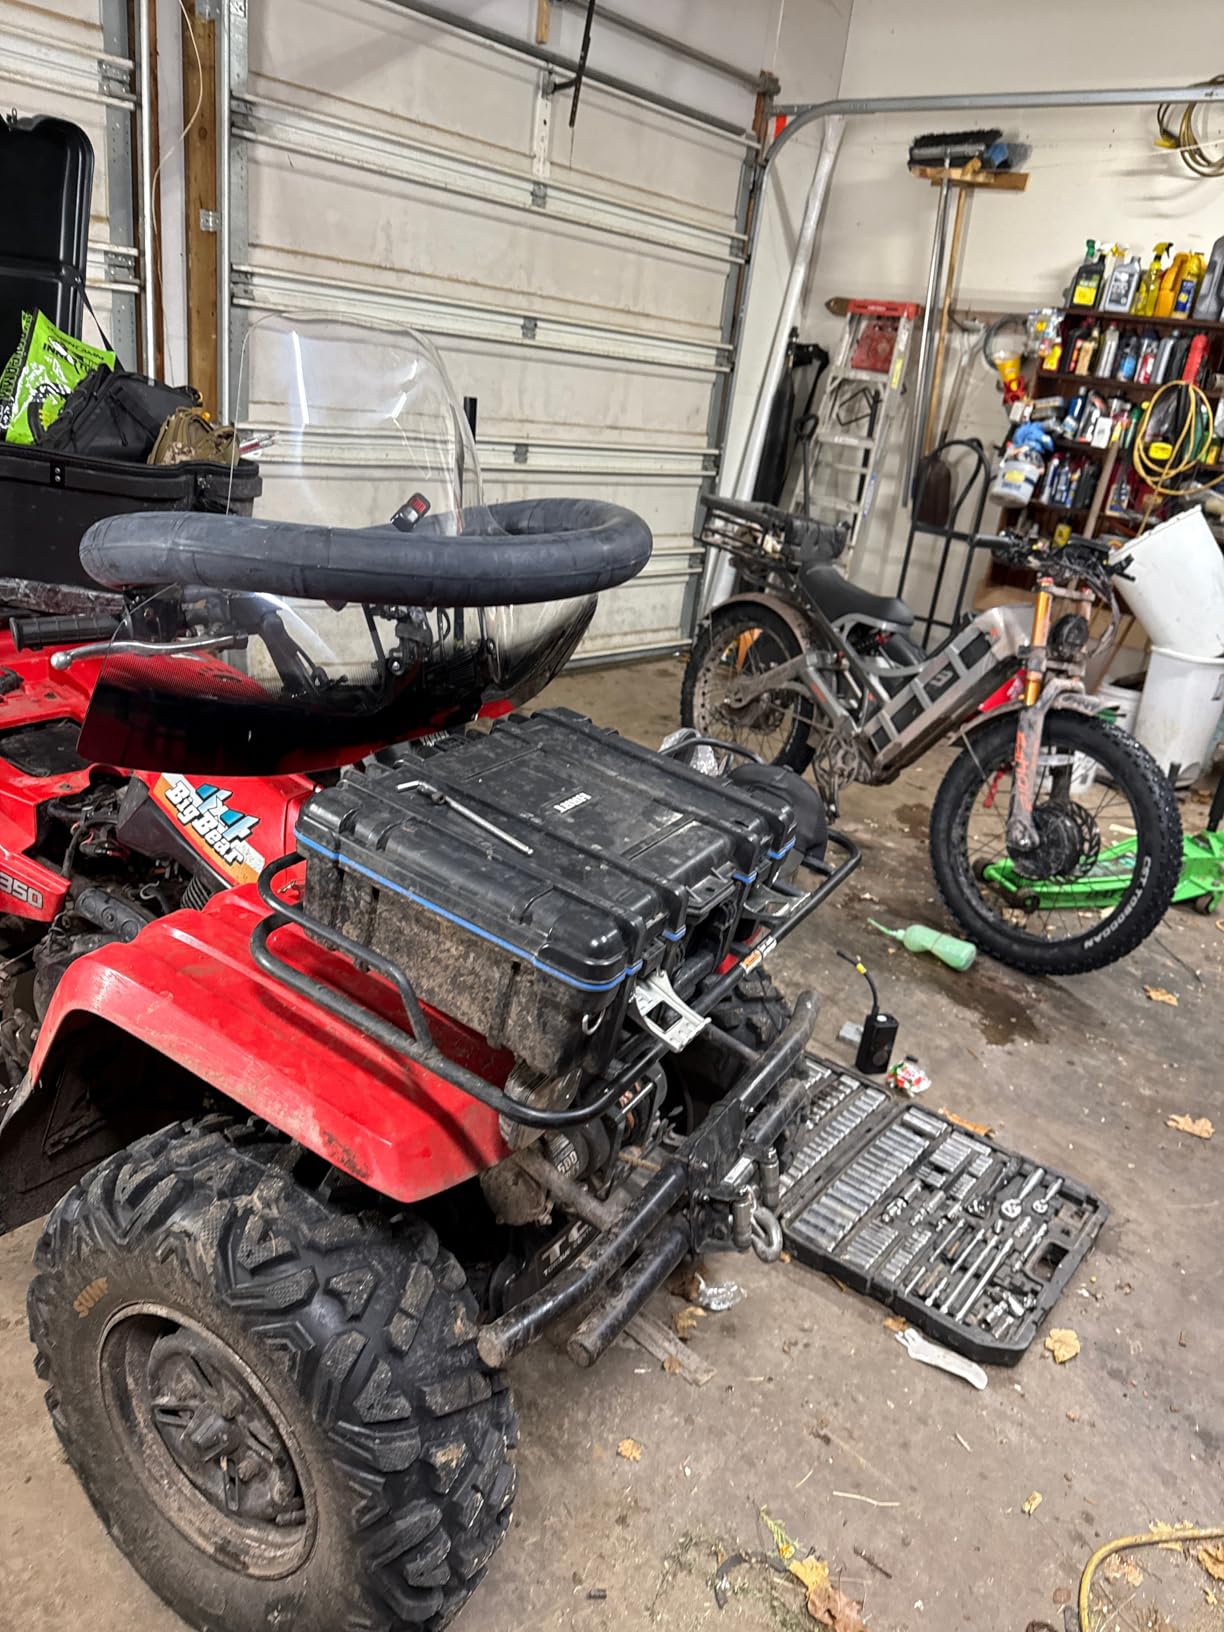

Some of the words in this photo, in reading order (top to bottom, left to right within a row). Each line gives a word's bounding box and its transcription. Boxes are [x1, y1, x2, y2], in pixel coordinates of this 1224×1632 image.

[164, 780, 201, 825] Big
[191, 807, 244, 866] Bear
[0, 871, 43, 909] 350
